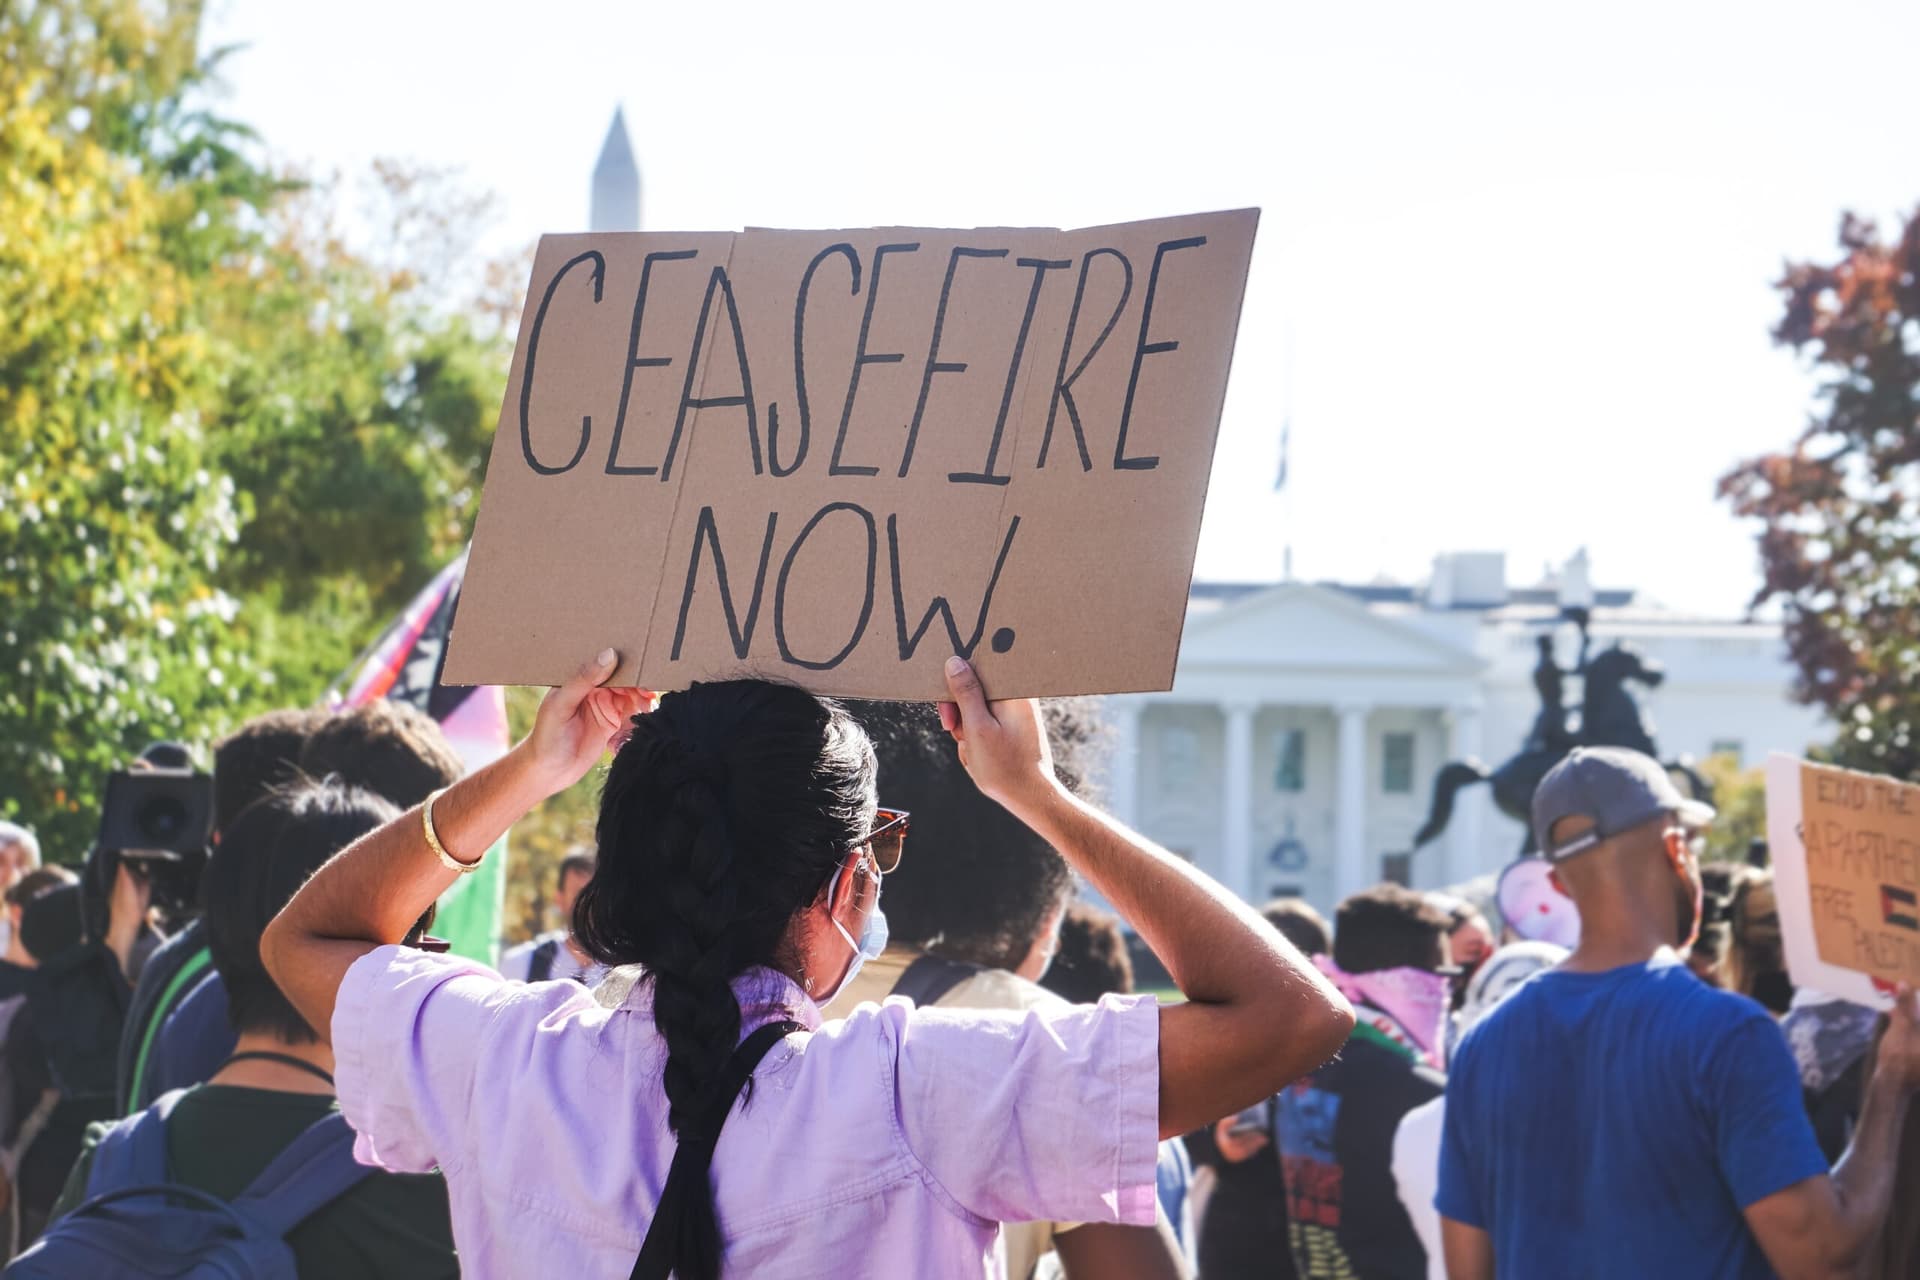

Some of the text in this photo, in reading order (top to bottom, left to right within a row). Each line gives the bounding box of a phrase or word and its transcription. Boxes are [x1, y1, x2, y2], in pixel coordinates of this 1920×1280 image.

[519, 236, 1206, 485] CEASEFIRE
[670, 501, 1020, 671] NOW.
[1872, 783, 1913, 816] THE
